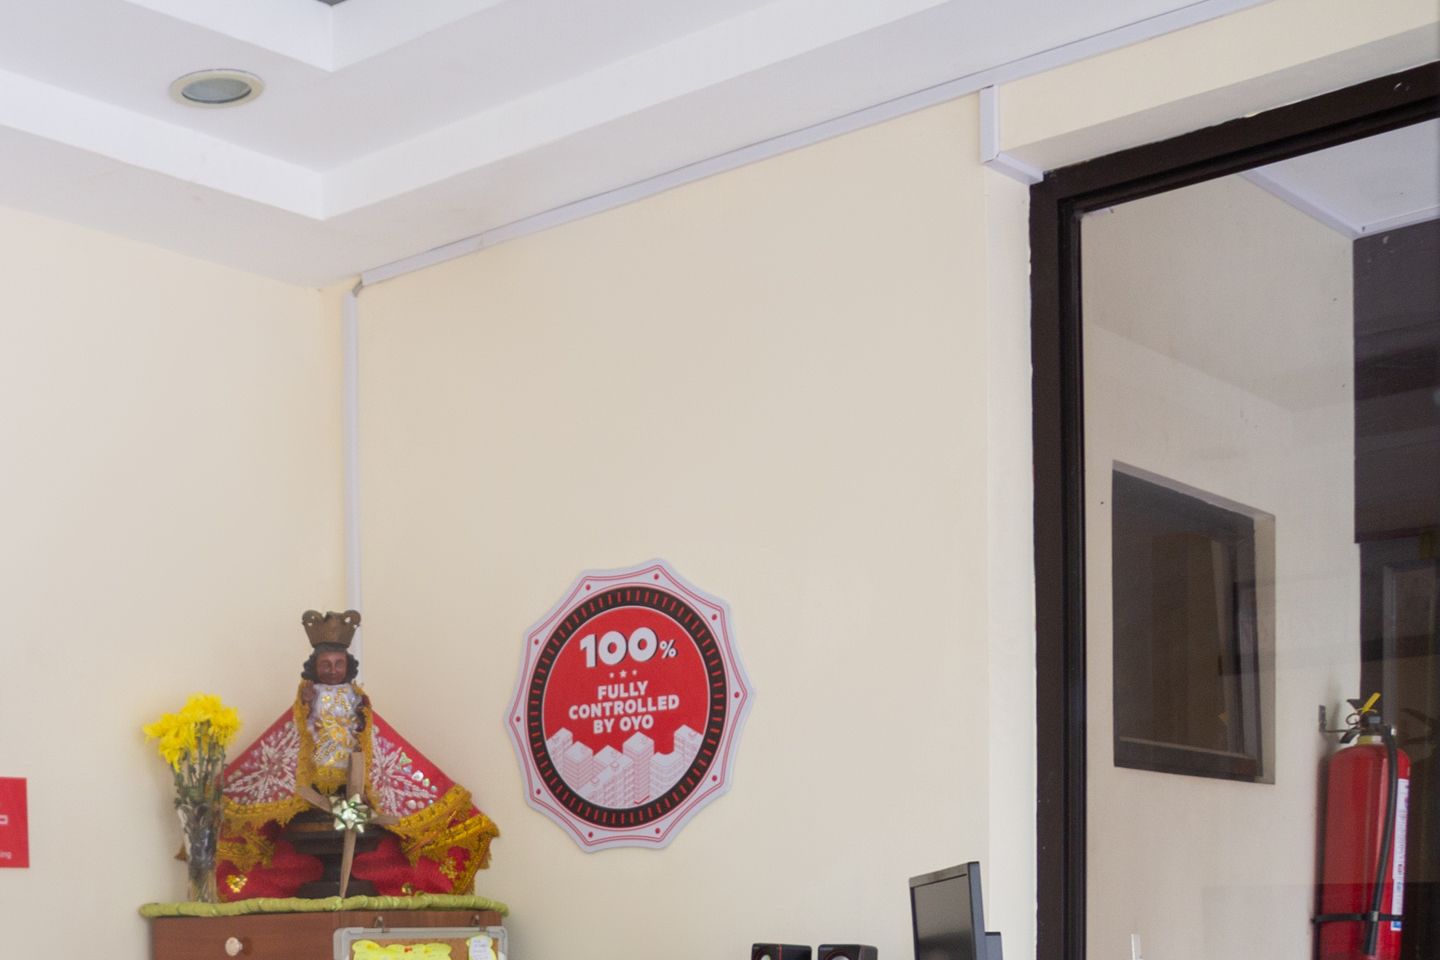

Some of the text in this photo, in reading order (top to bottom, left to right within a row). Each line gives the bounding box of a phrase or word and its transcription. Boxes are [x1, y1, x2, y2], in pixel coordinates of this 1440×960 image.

[580, 627, 677, 668] 100%
[597, 680, 648, 700] FULLY
[568, 694, 680, 720] CONTROLLED
[593, 714, 654, 735] BY OYO
